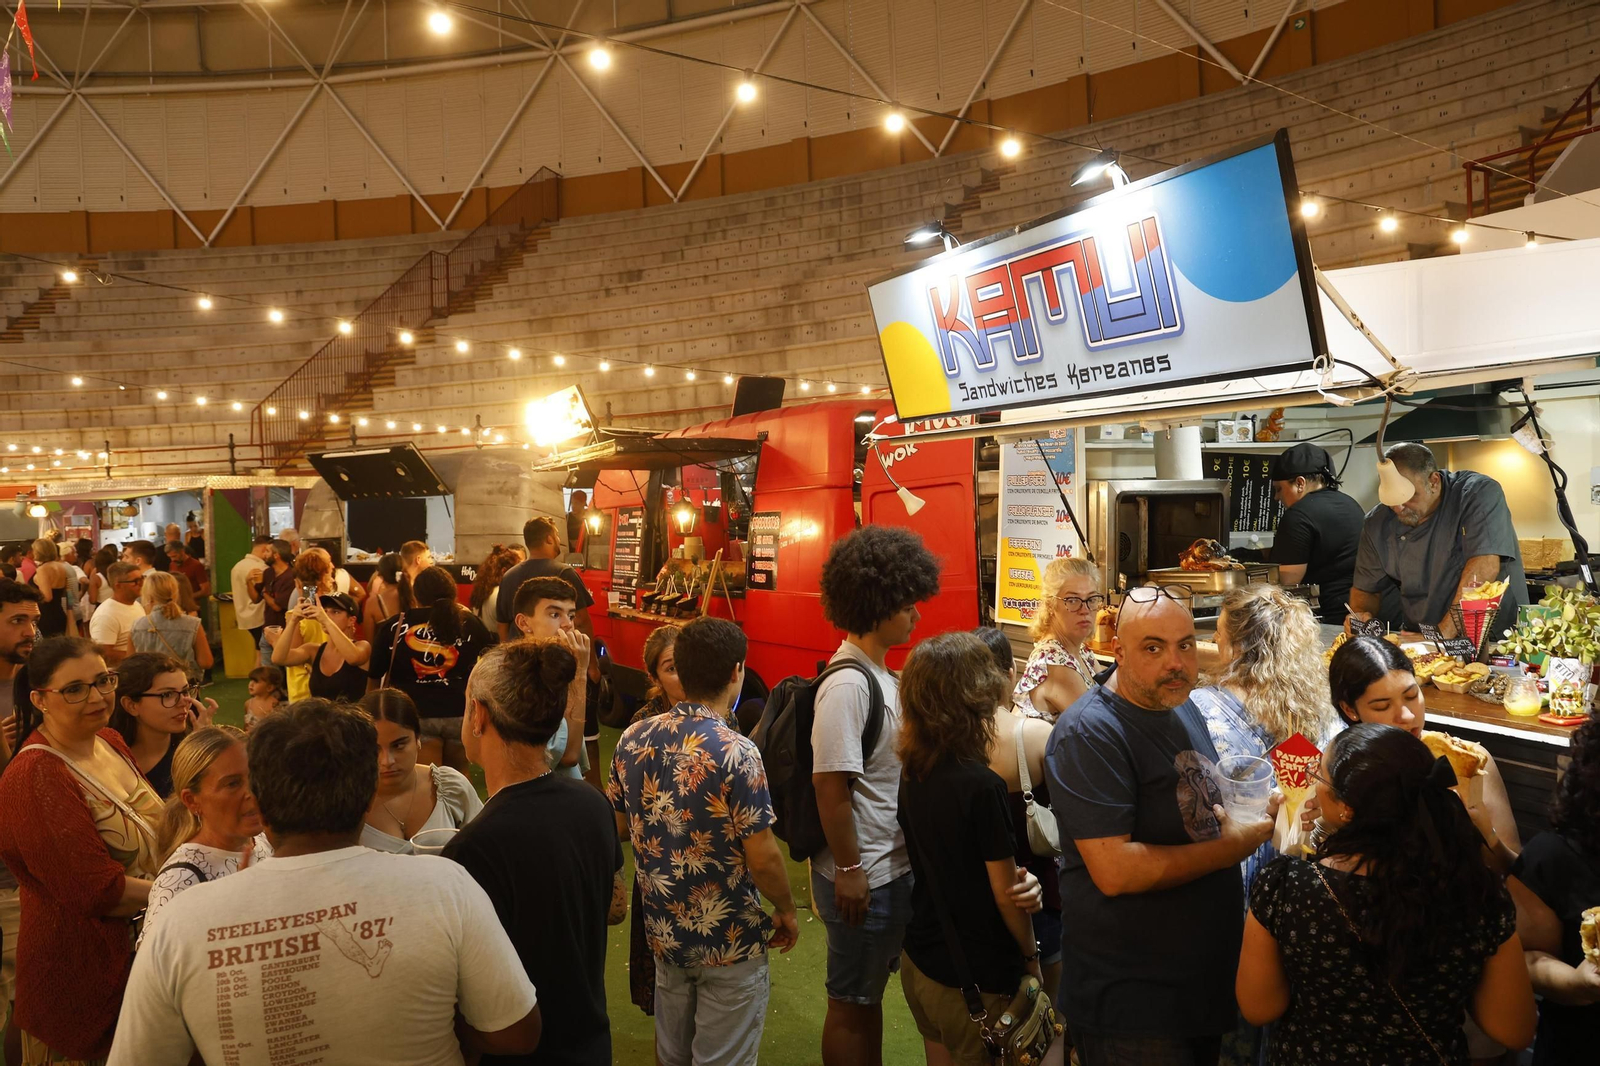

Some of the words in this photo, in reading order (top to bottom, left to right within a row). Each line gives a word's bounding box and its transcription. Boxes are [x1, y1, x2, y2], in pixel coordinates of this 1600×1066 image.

[928, 213, 1182, 376] KAMUI
[958, 372, 1057, 402] Sandwiches
[1067, 353, 1171, 390] Koreanos
[882, 443, 918, 468] WOK
[1213, 458, 1221, 471] 9€
[1243, 460, 1251, 478] 10€
[1056, 472, 1072, 485] 10€
[1056, 510, 1072, 523] 10€
[1056, 544, 1072, 558] 10€
[1276, 749, 1320, 763] PATATAS
[207, 902, 358, 942] STEELEYESPAN
[207, 932, 321, 970] BRITISH
[261, 954, 321, 971] CANTERBURY
[261, 962, 320, 978] EASTBOURNE
[262, 975, 292, 986] POOLE
[262, 980, 300, 993] LONDON
[262, 987, 307, 1000] CROYDON
[263, 991, 317, 1007] LOWESTOFT
[263, 999, 316, 1015] STEVENAGE
[264, 1009, 302, 1021] OXFORD
[265, 1014, 308, 1028] SWANSEA
[265, 1020, 315, 1034] CARDIGAN
[267, 1032, 303, 1044] HANLEY
[268, 1034, 320, 1050] LANCASTER
[269, 1046, 296, 1056] LEEDS
[270, 1044, 330, 1062] MANCHESTER
